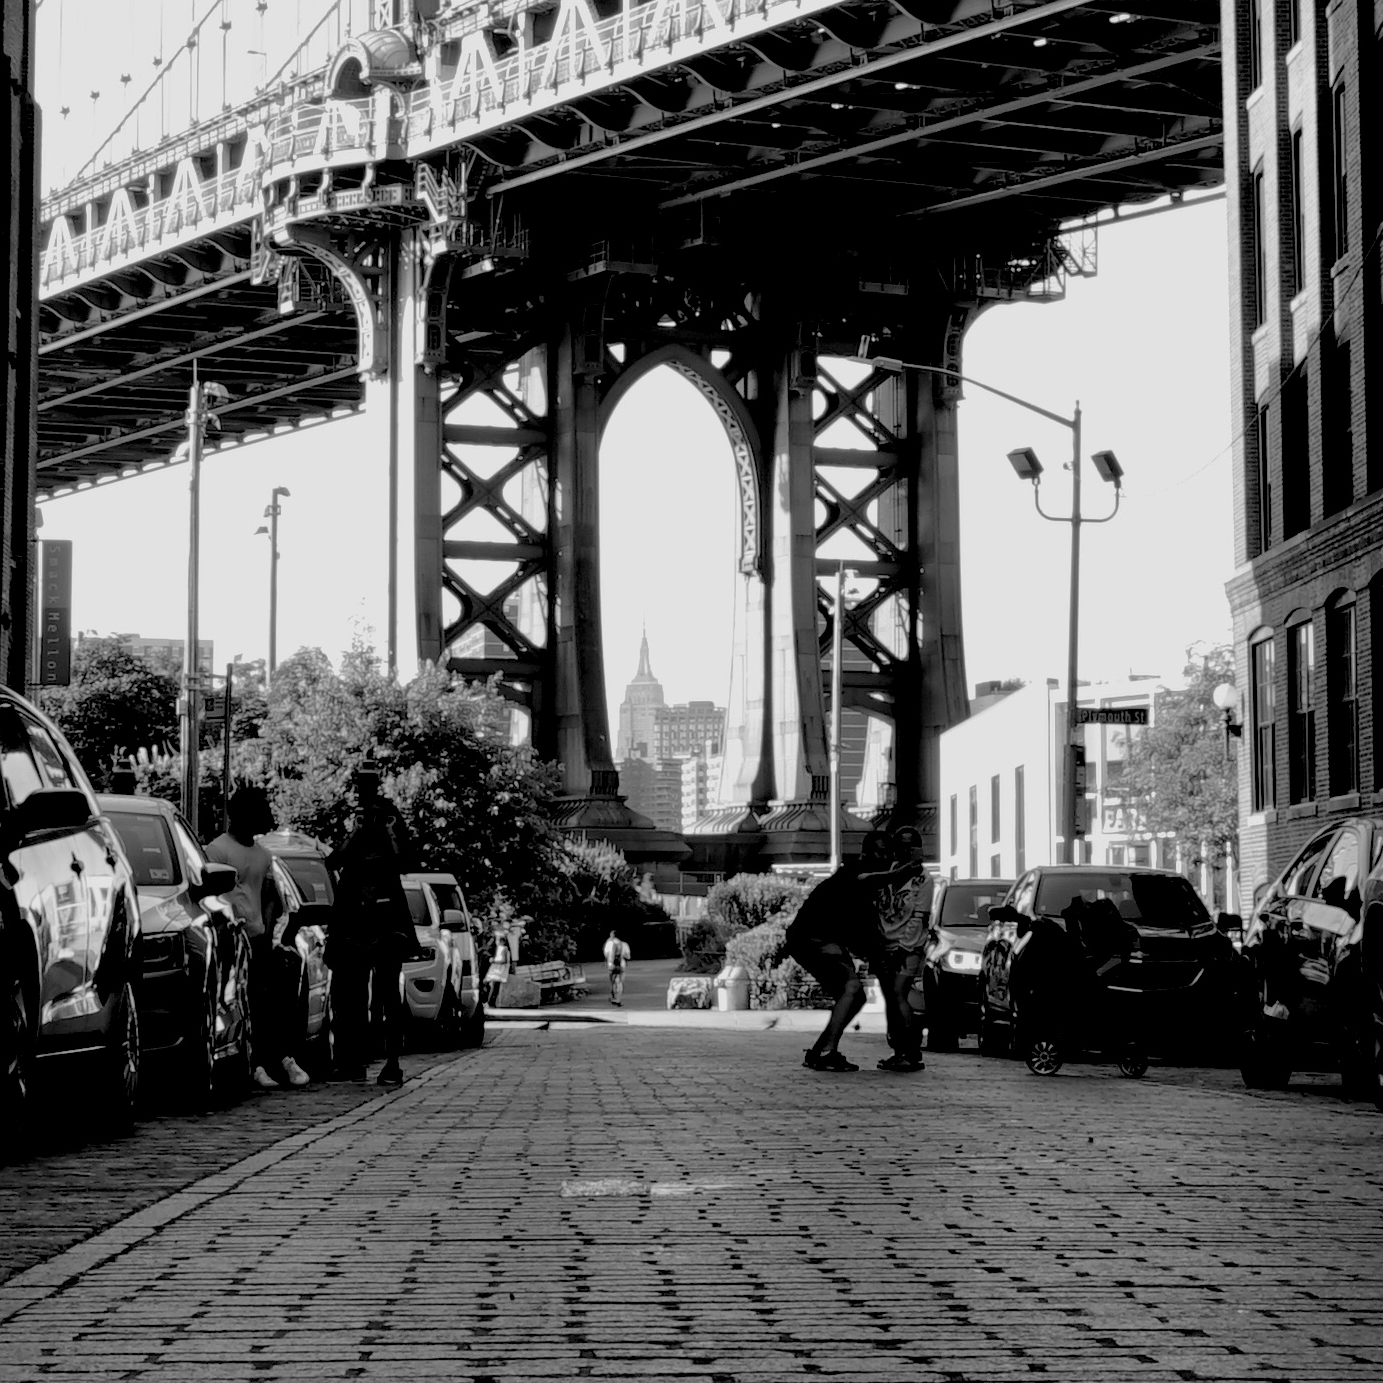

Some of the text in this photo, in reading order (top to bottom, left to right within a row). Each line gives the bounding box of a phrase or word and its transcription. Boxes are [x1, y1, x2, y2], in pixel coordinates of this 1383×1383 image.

[48, 545, 61, 604] Smack
[1082, 710, 1145, 723] Plymouth St
